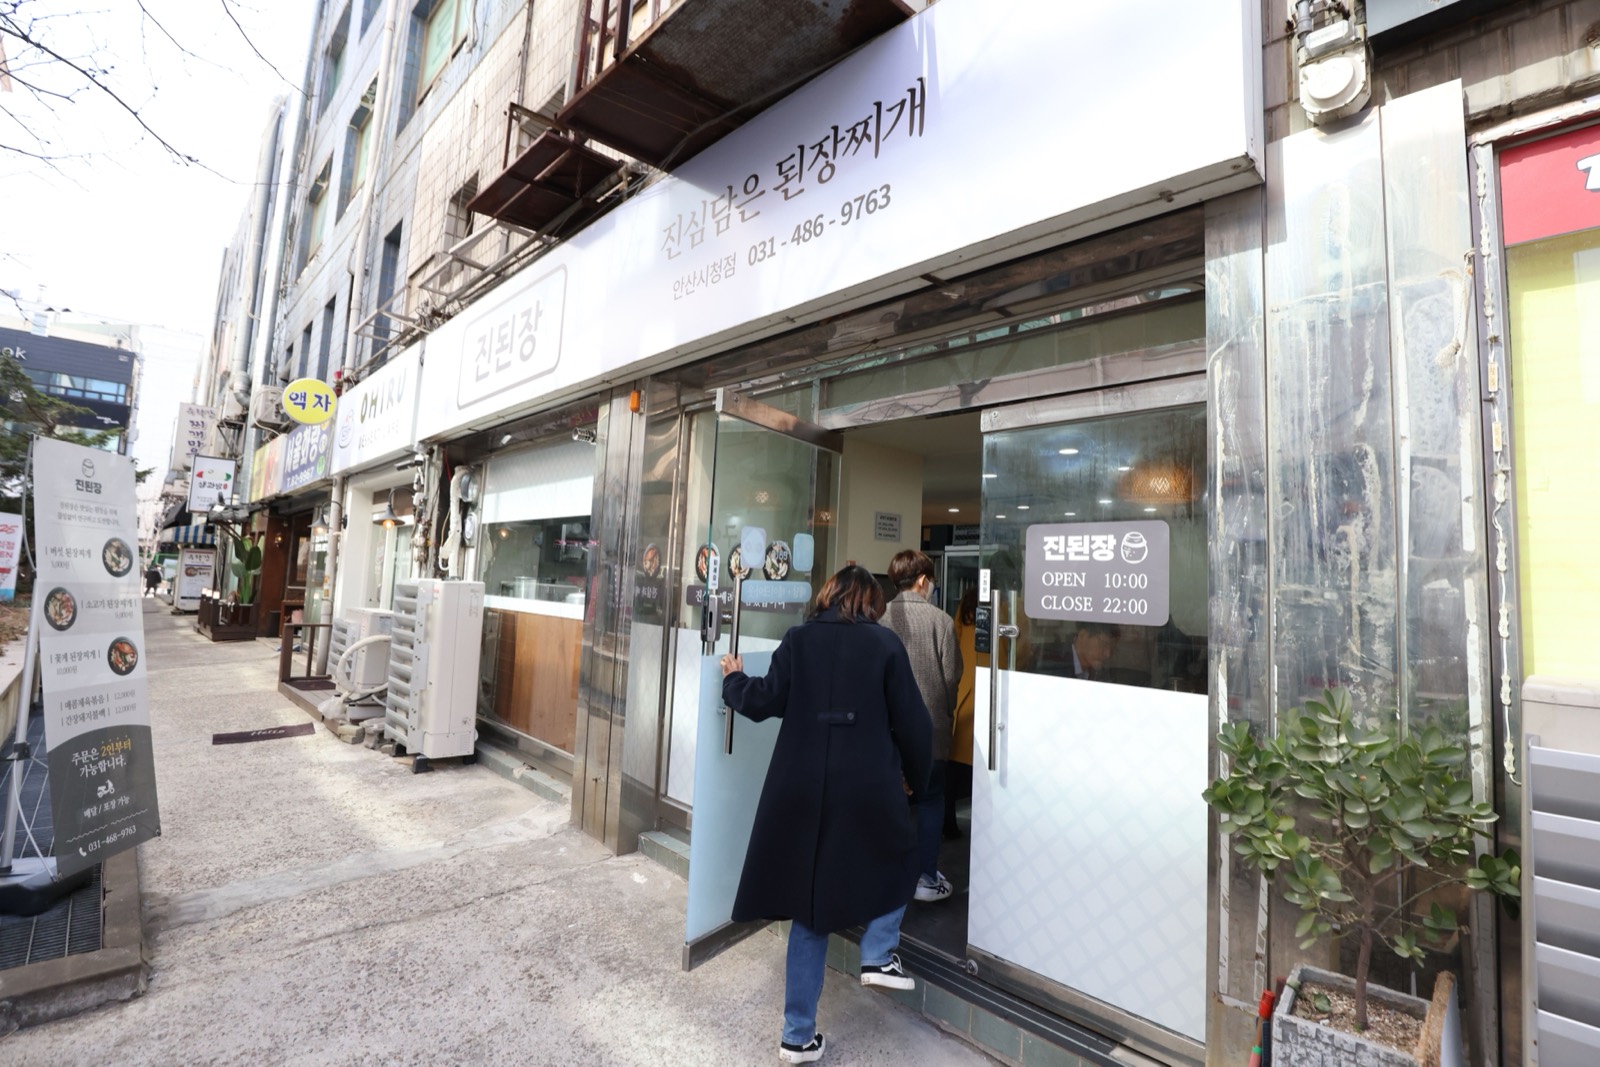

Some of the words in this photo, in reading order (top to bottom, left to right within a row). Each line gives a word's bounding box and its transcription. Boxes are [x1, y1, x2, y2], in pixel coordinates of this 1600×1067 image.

[660, 174, 766, 260] 진심담은
[772, 76, 926, 201] 된장찌개
[673, 251, 737, 301] 안산시청점
[474, 300, 543, 383] 진된장
[360, 367, 407, 424] OHIRU
[75, 479, 102, 494] 진된장
[1042, 533, 1117, 562] 진된장
[1042, 571, 1087, 588] OPEN
[1104, 572, 1148, 589] 10:00
[85, 599, 106, 609] 소고기
[1041, 595, 1093, 612] CLOSE
[1102, 597, 1148, 615] 22:00
[72, 747, 100, 766] 주문은
[100, 738, 132, 758] 2인부터
[80, 754, 127, 779] 가능합니다.
[83, 805, 98, 819] 배달
[103, 799, 116, 813] 포장
[118, 795, 131, 807] 가능
[88, 824, 137, 852] 031-468-9763
